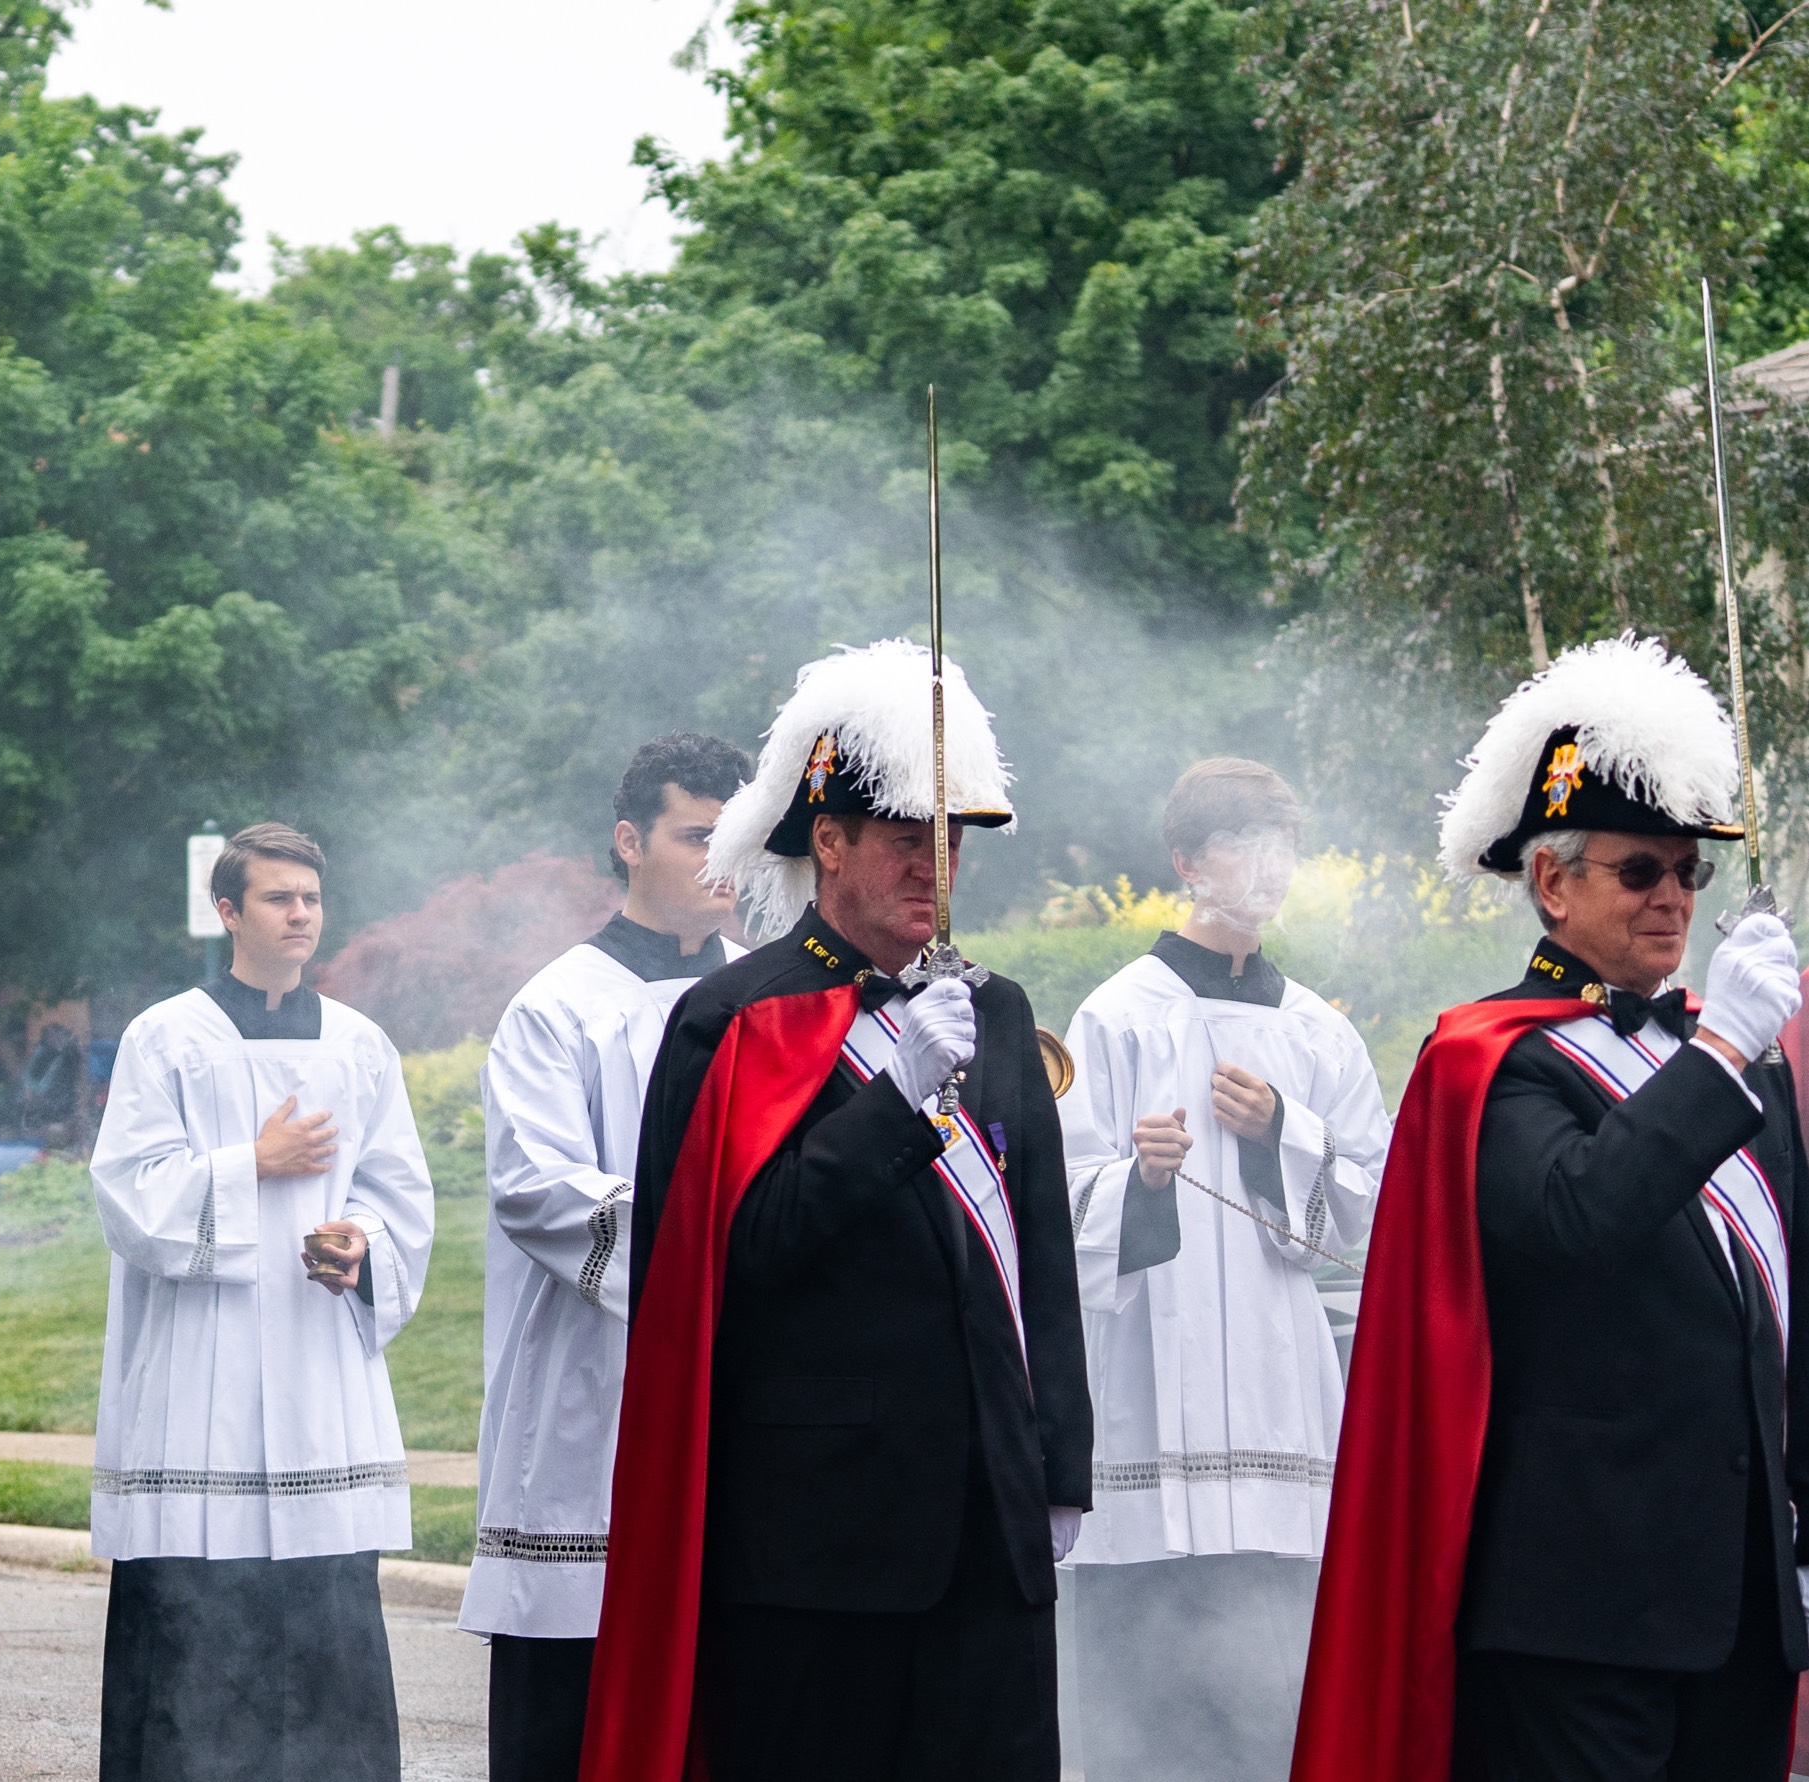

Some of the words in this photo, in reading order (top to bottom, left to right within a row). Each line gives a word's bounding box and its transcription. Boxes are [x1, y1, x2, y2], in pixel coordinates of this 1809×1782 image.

[804, 936, 819, 950] K
[826, 956, 839, 969] C
[1531, 955, 1543, 969] K
[1552, 965, 1565, 980] C
